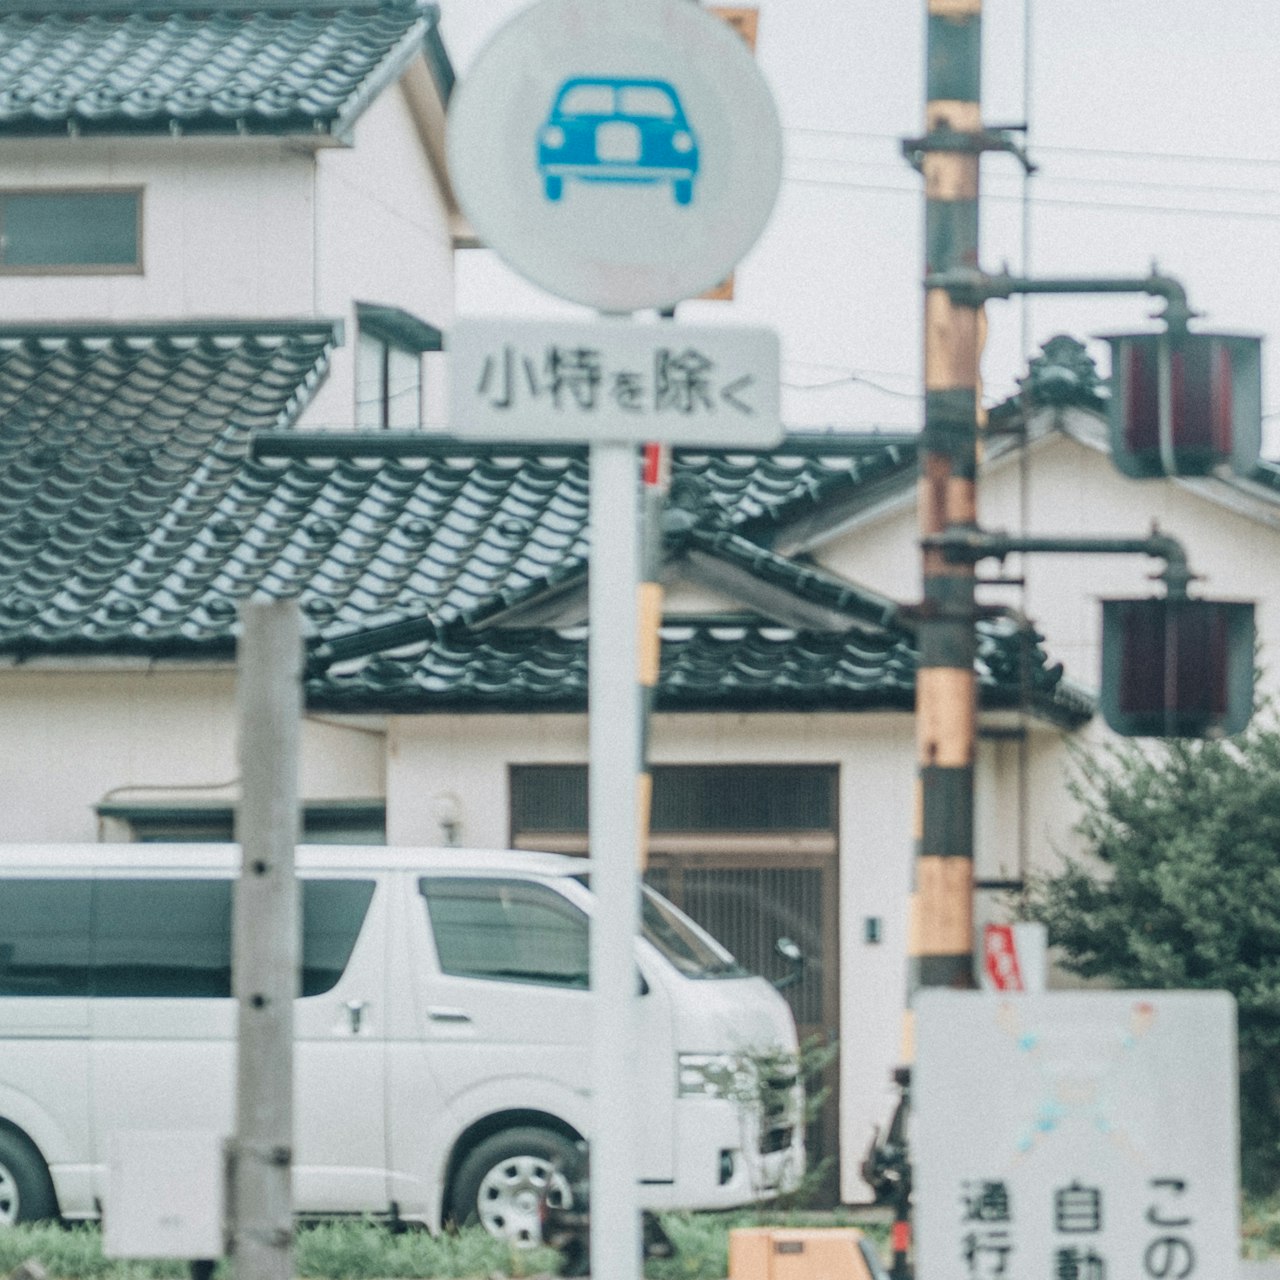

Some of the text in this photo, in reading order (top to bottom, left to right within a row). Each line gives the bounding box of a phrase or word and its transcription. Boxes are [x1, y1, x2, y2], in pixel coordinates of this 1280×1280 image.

[479, 346, 753, 415] 小特を除く
